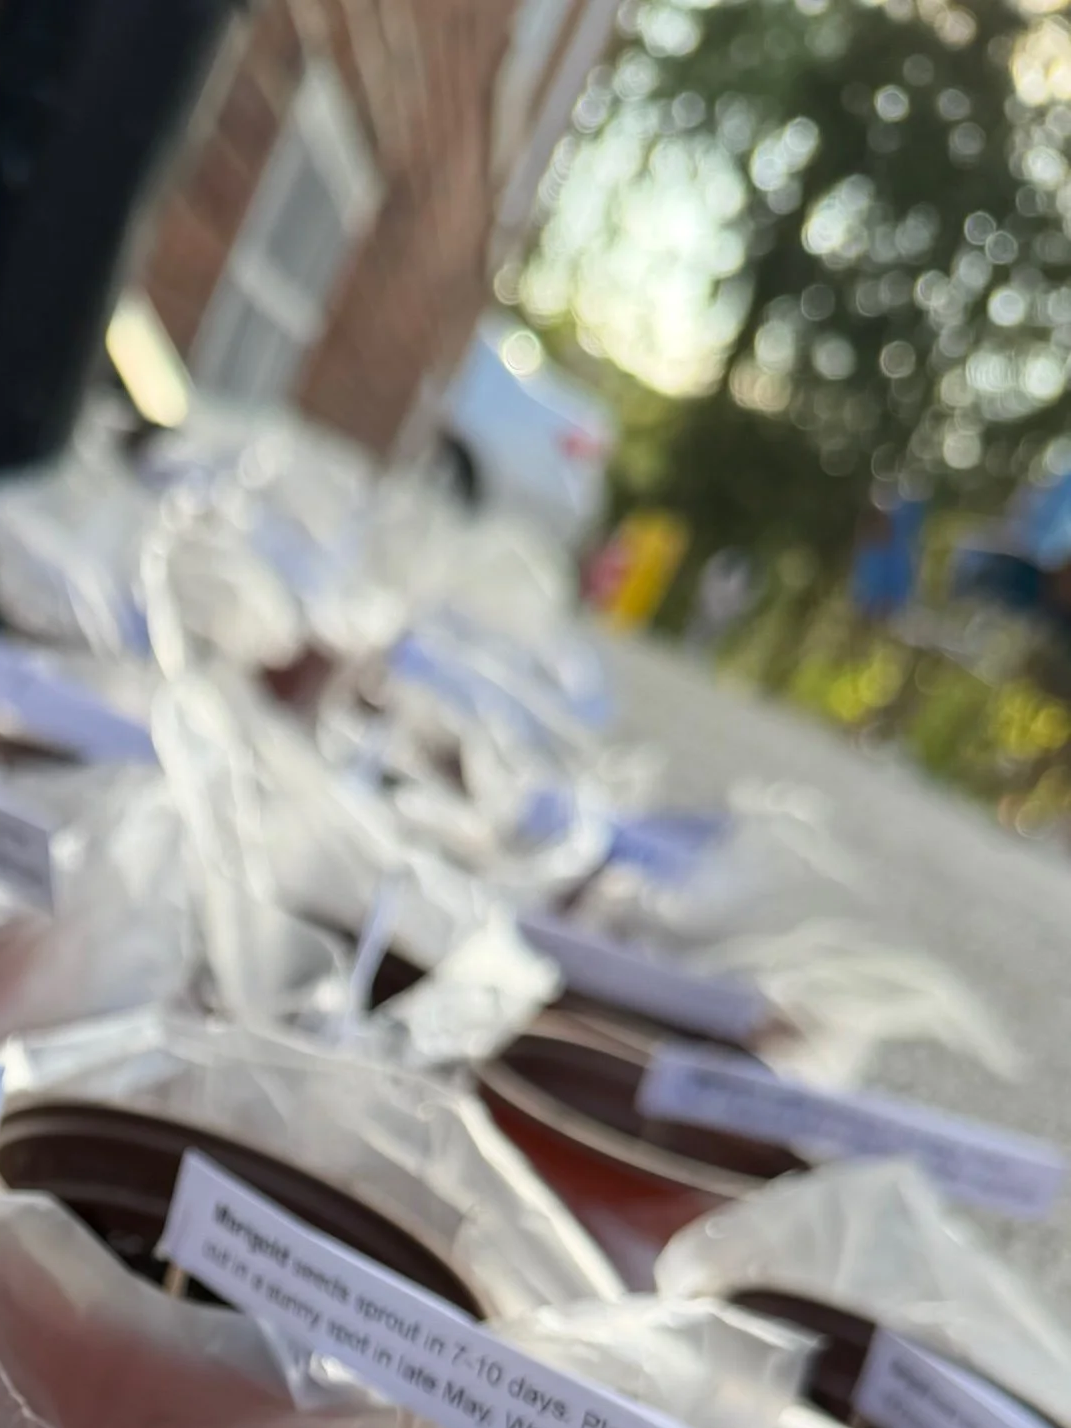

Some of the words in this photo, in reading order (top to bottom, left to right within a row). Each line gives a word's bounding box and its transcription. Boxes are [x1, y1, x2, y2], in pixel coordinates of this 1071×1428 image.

[202, 1239, 228, 1270] out
[231, 1256, 247, 1278] in
[265, 1283, 322, 1331] sunny
[327, 1319, 370, 1357] spot
[372, 1344, 393, 1369] in
[397, 1354, 437, 1392] late
[214, 1200, 290, 1267] Marigold
[292, 1259, 349, 1301] seeds
[356, 1293, 421, 1343] sprout
[423, 1329, 445, 1357] in
[450, 1340, 503, 1387] 7-10
